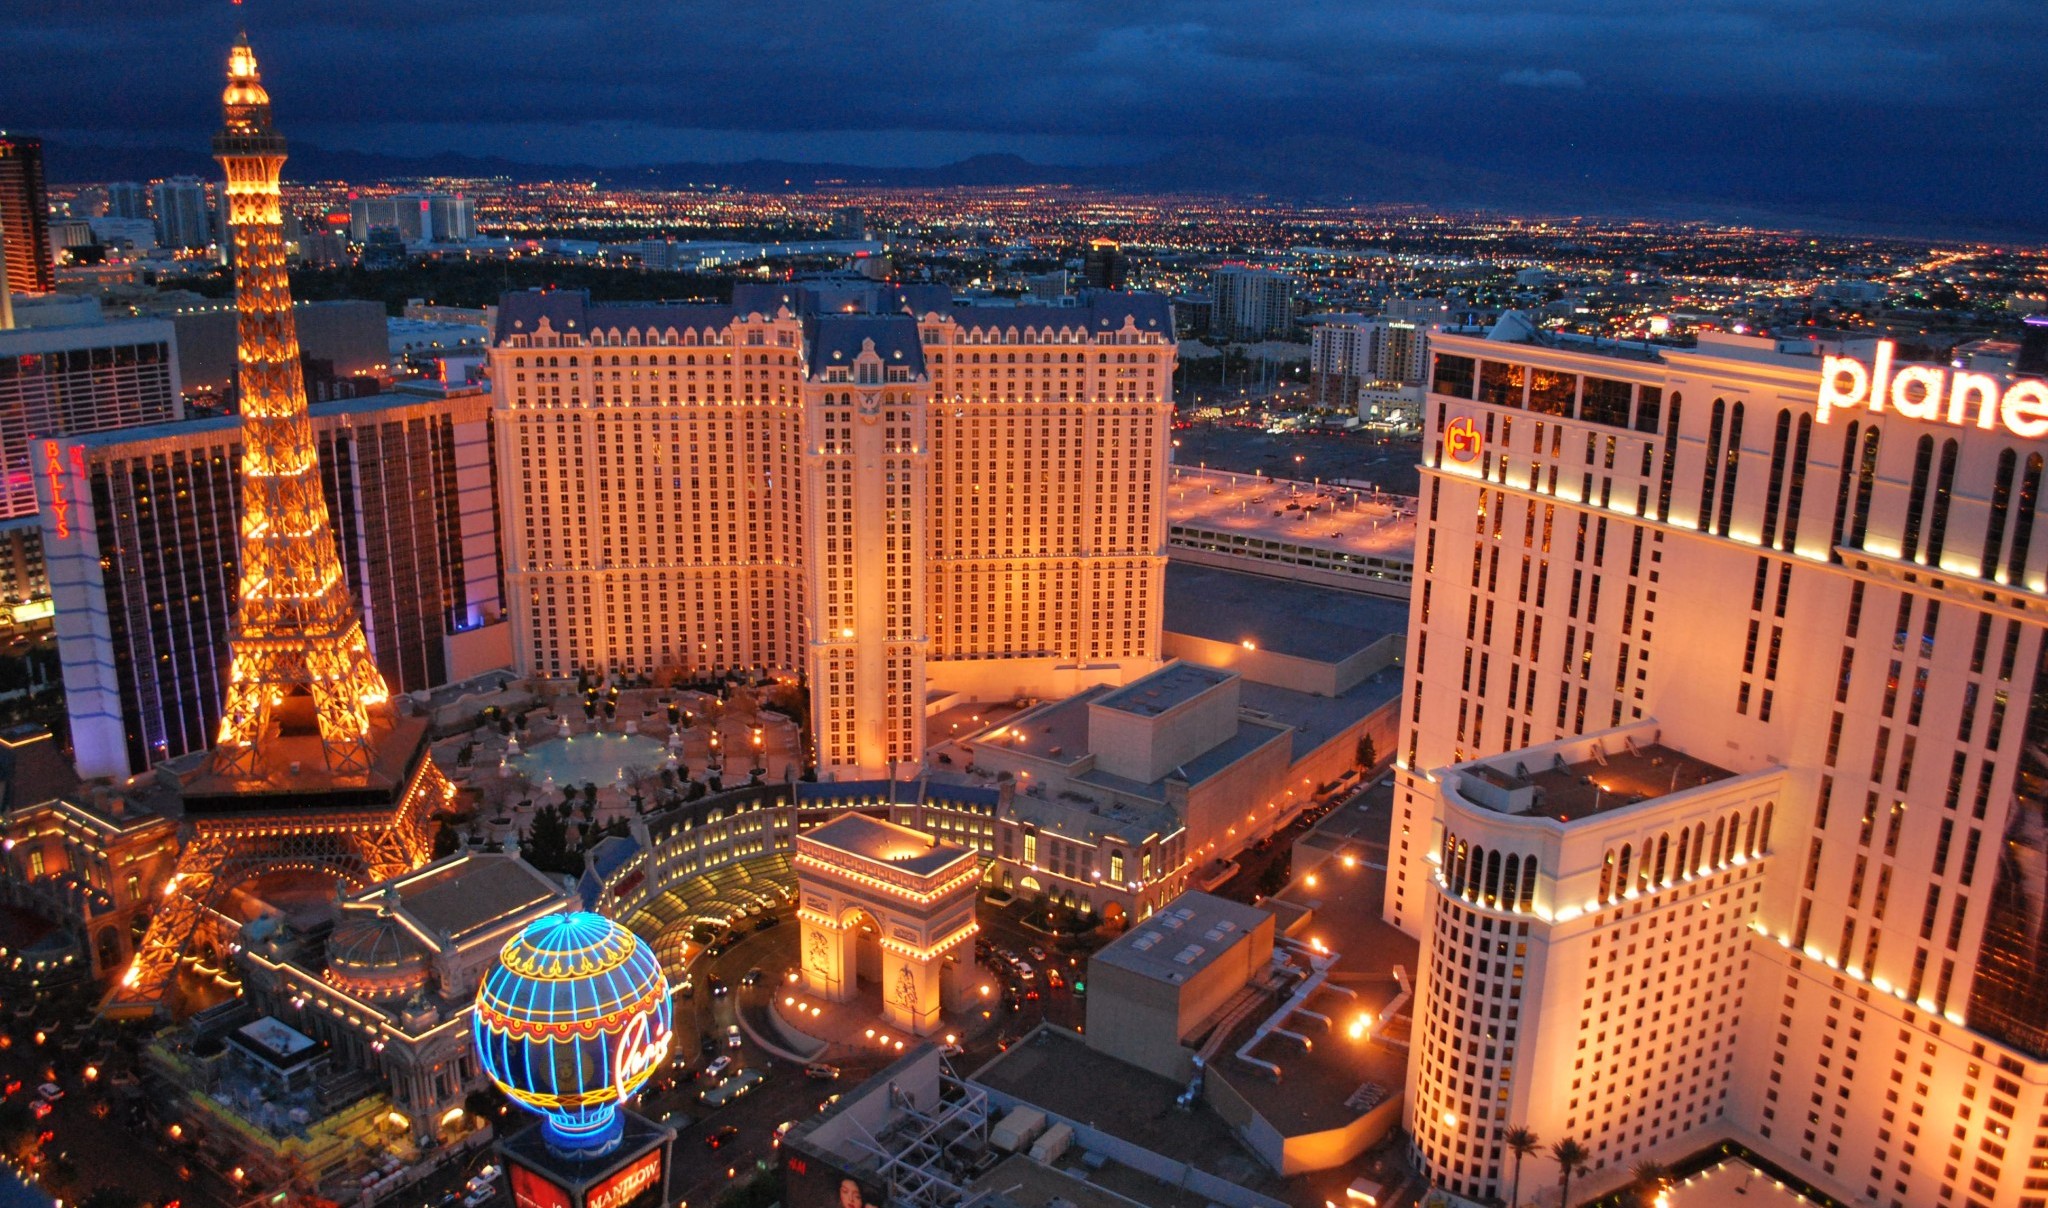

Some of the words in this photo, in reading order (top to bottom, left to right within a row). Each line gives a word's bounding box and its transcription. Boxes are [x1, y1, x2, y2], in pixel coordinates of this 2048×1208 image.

[1815, 340, 2048, 439] plane
[1448, 417, 1482, 456] ph
[615, 1010, 673, 1103] Paris
